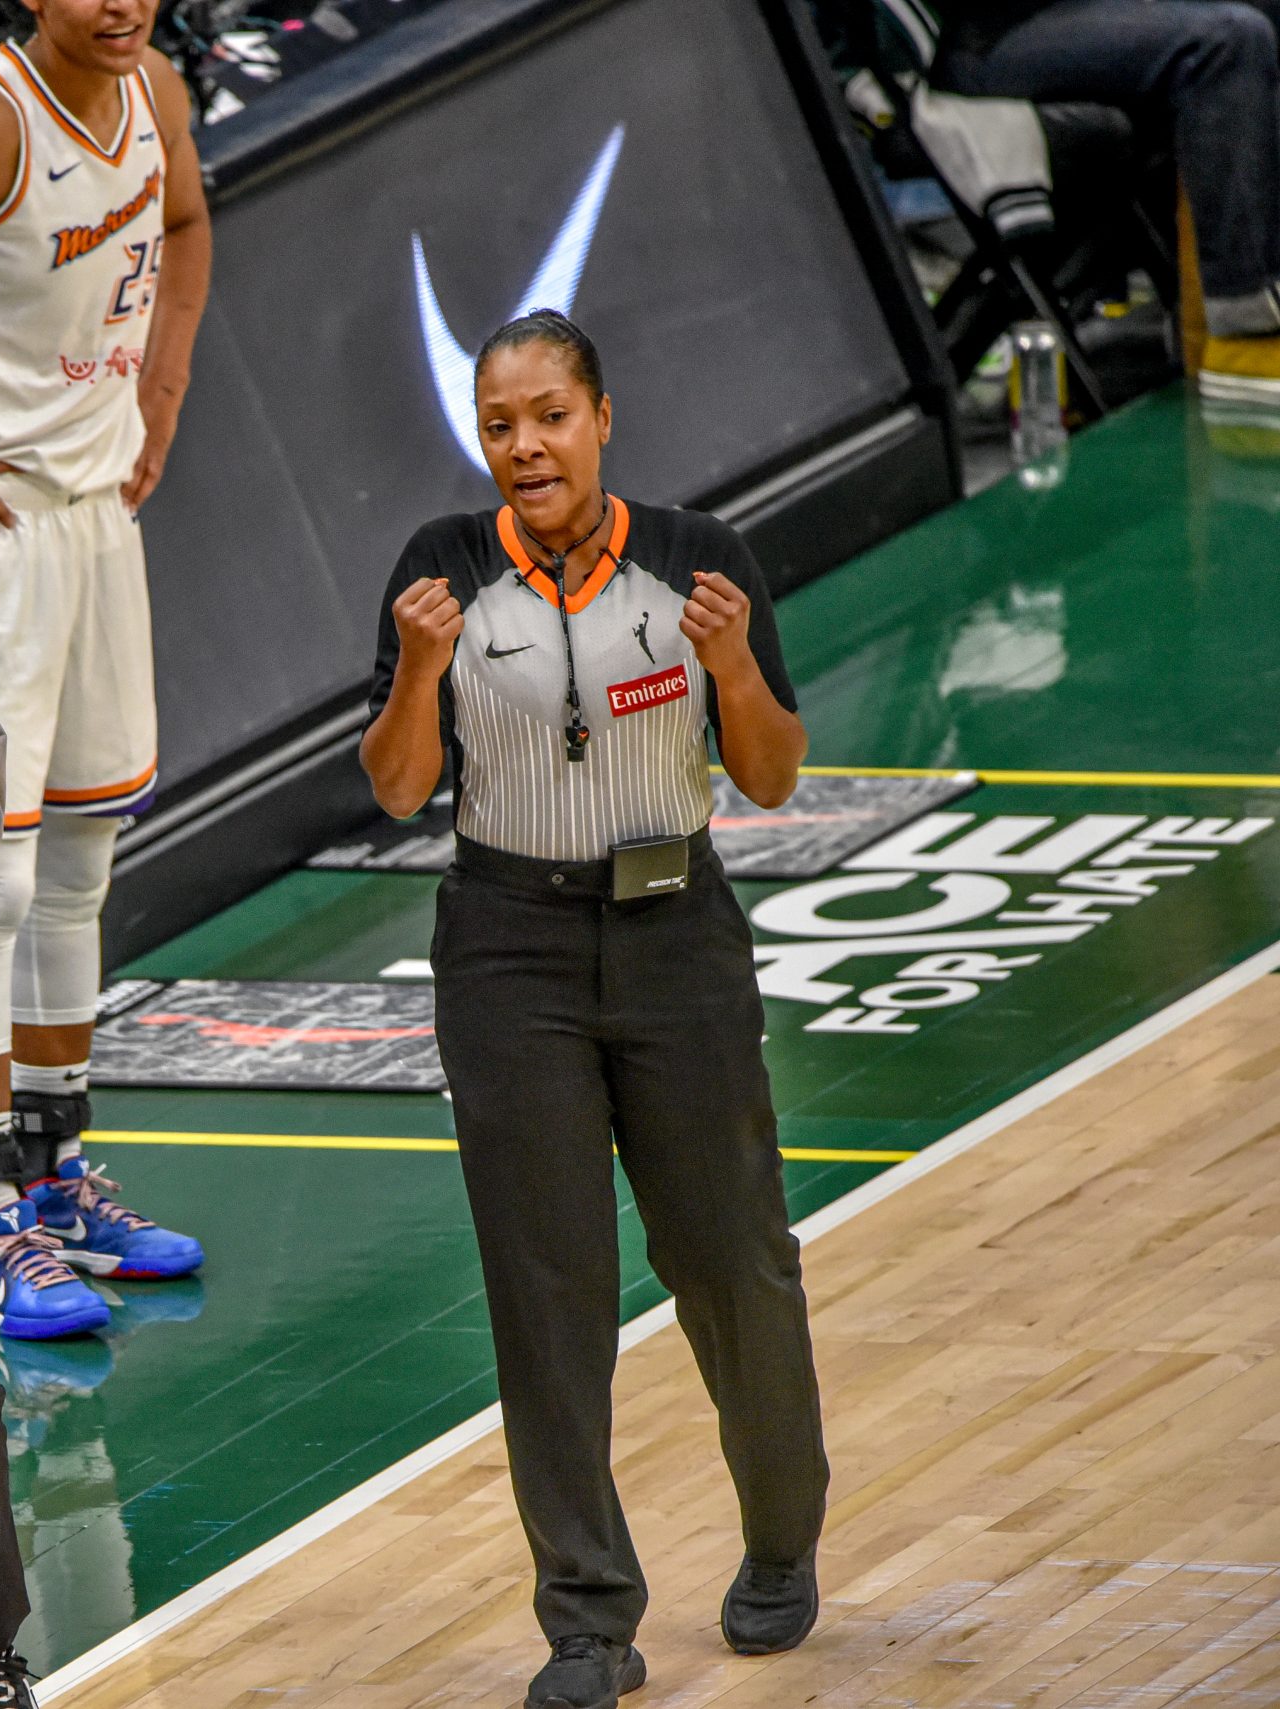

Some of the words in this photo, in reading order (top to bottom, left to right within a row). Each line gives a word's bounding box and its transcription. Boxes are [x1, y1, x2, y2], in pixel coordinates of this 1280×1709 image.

[610, 674, 686, 710] Emirates
[750, 812, 1149, 1004] ACE
[803, 951, 1044, 1034] FOR
[996, 815, 1276, 923] HATE
